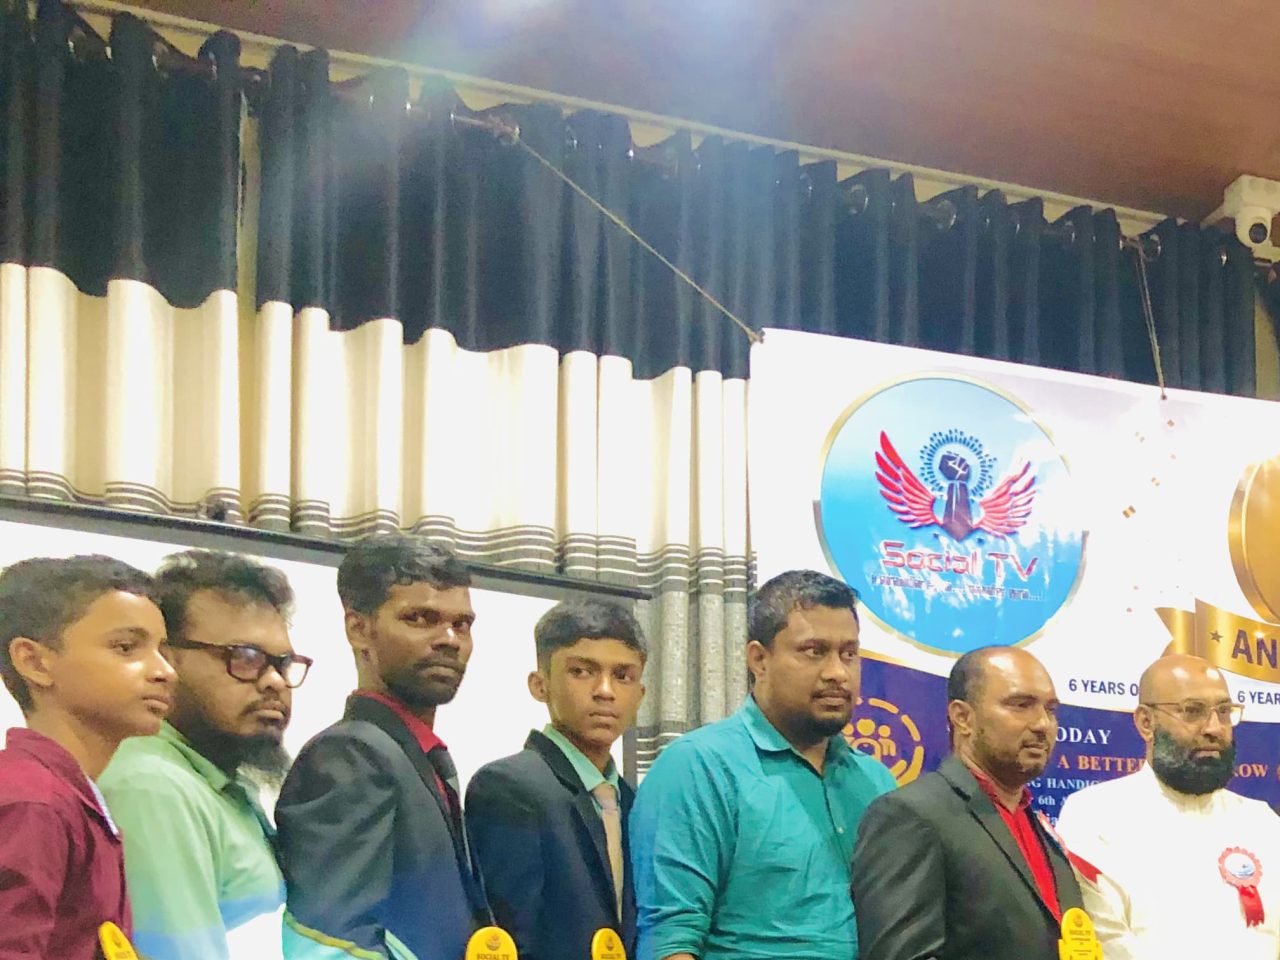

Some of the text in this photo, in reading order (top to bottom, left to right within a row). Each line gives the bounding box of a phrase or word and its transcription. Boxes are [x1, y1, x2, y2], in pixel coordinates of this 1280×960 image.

[881, 541, 1038, 582] Social TV
[1068, 678, 1139, 696] 6 YEARS O
[1237, 690, 1246, 703] 6
[1056, 727, 1111, 745] ODAY
[1057, 754, 1070, 769] A
